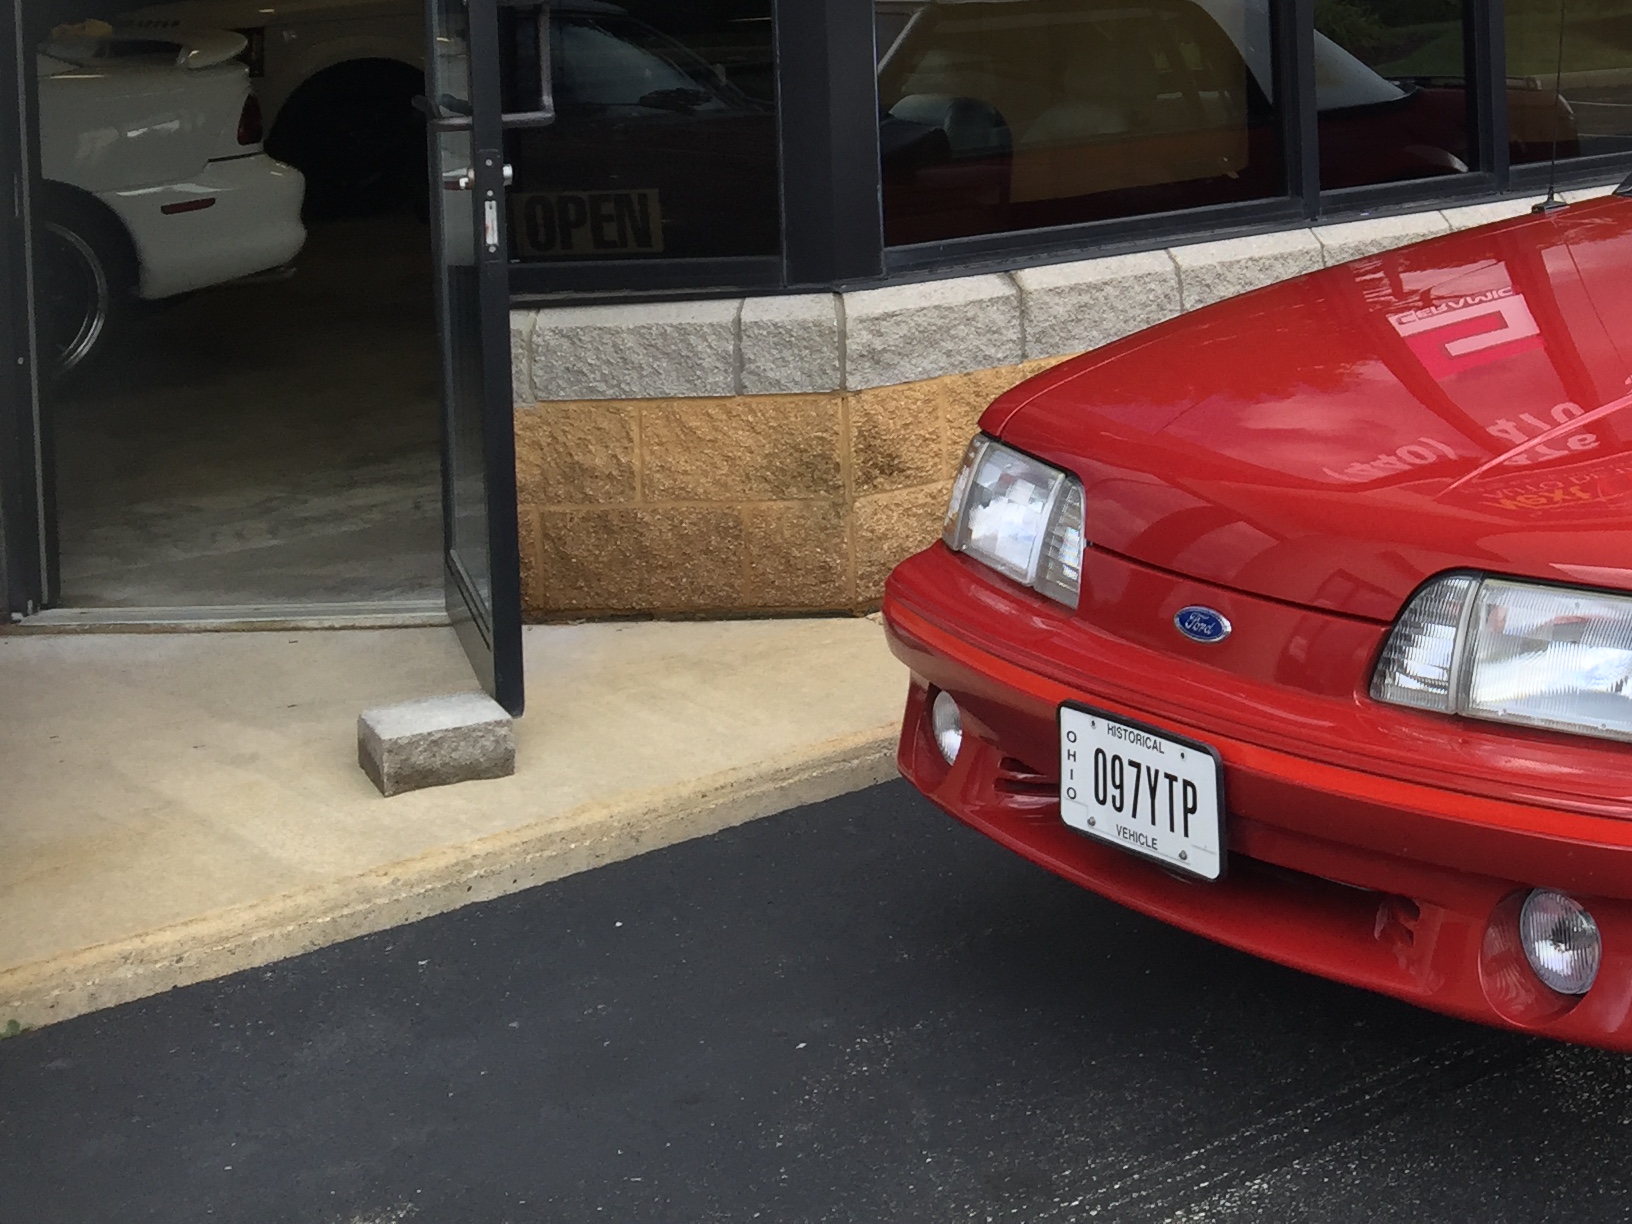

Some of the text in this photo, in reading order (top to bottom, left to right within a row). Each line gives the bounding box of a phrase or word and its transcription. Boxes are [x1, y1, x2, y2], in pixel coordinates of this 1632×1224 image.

[523, 192, 654, 252] OPEN
[1184, 611, 1218, 636] Ford
[1107, 722, 1165, 755] HISTORICAL
[1066, 730, 1077, 800] OHIO
[1094, 747, 1198, 838] 097YTP
[1116, 823, 1159, 851] VEHICLE
